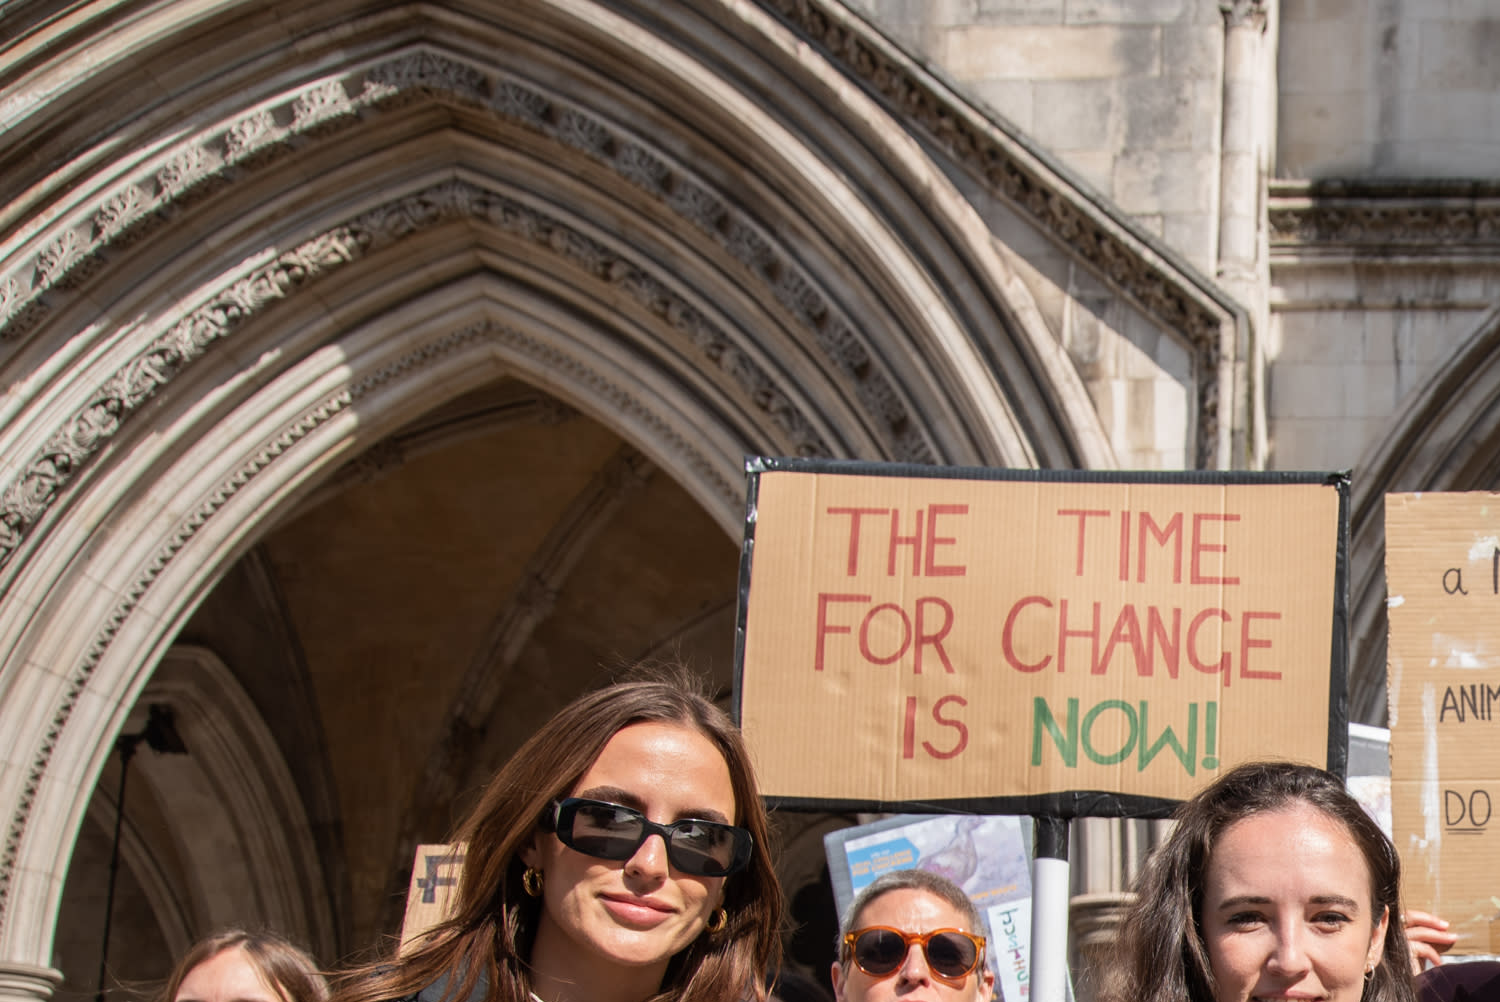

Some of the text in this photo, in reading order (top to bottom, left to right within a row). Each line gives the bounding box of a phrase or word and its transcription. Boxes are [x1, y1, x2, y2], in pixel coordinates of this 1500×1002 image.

[826, 503, 1241, 585] THE TIME
[1442, 566, 1469, 596] a
[814, 593, 1283, 688] FOR CHANGE
[902, 694, 1220, 778] IS NOW!
[1444, 788, 1492, 828] DO
